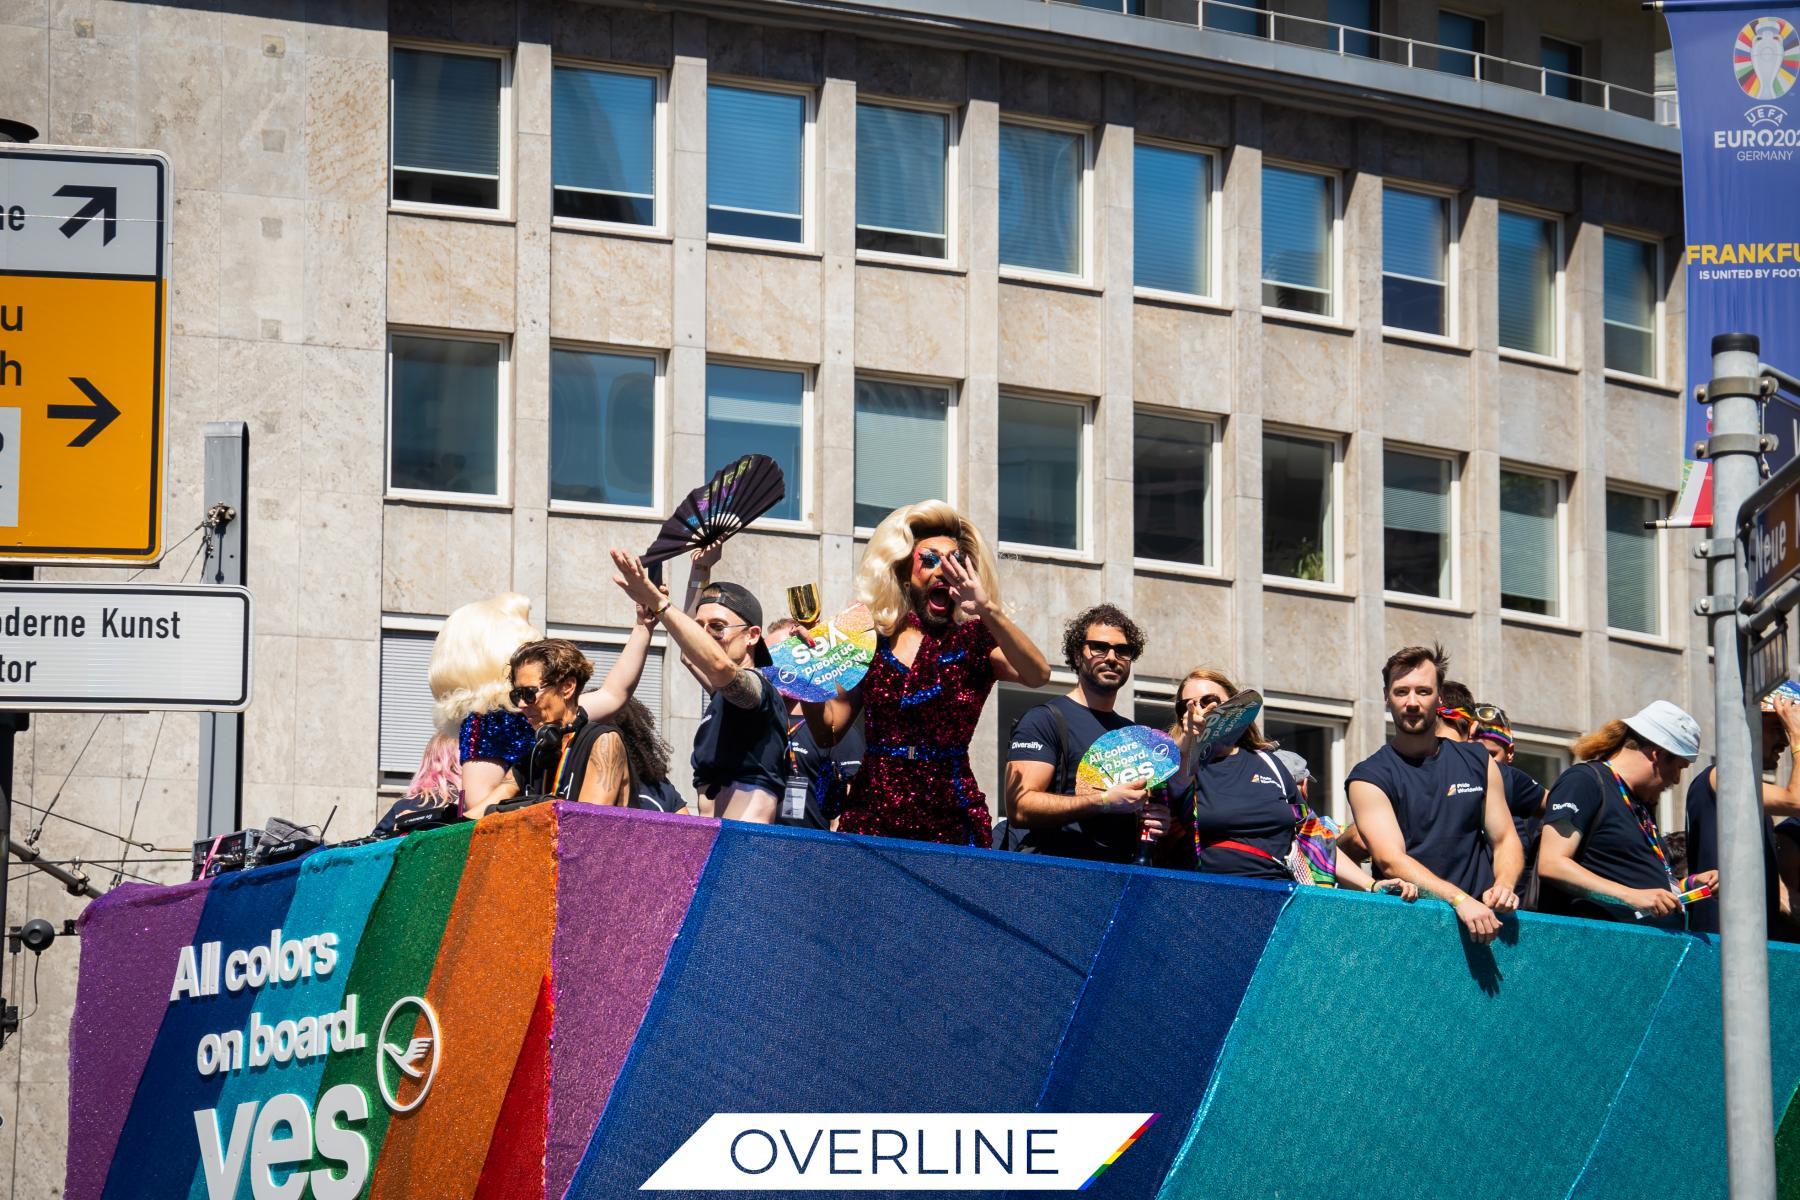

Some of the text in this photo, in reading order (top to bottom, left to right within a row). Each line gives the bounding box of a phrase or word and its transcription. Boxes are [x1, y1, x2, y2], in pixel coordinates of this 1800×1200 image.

[1746, 108, 1784, 124] UEFA
[1736, 150, 1794, 161] GERMANY
[1699, 270, 1710, 280] IS
[1711, 269, 1753, 280] UNITED
[1755, 268, 1770, 279] BY
[1755, 520, 1787, 581] Neue
[0, 606, 181, 639] derne Kunst
[1089, 741, 1138, 765] All colors
[1114, 750, 1149, 768] board.
[169, 928, 338, 1002] All colors
[197, 993, 367, 1077] on board.
[193, 1083, 370, 1200] yes
